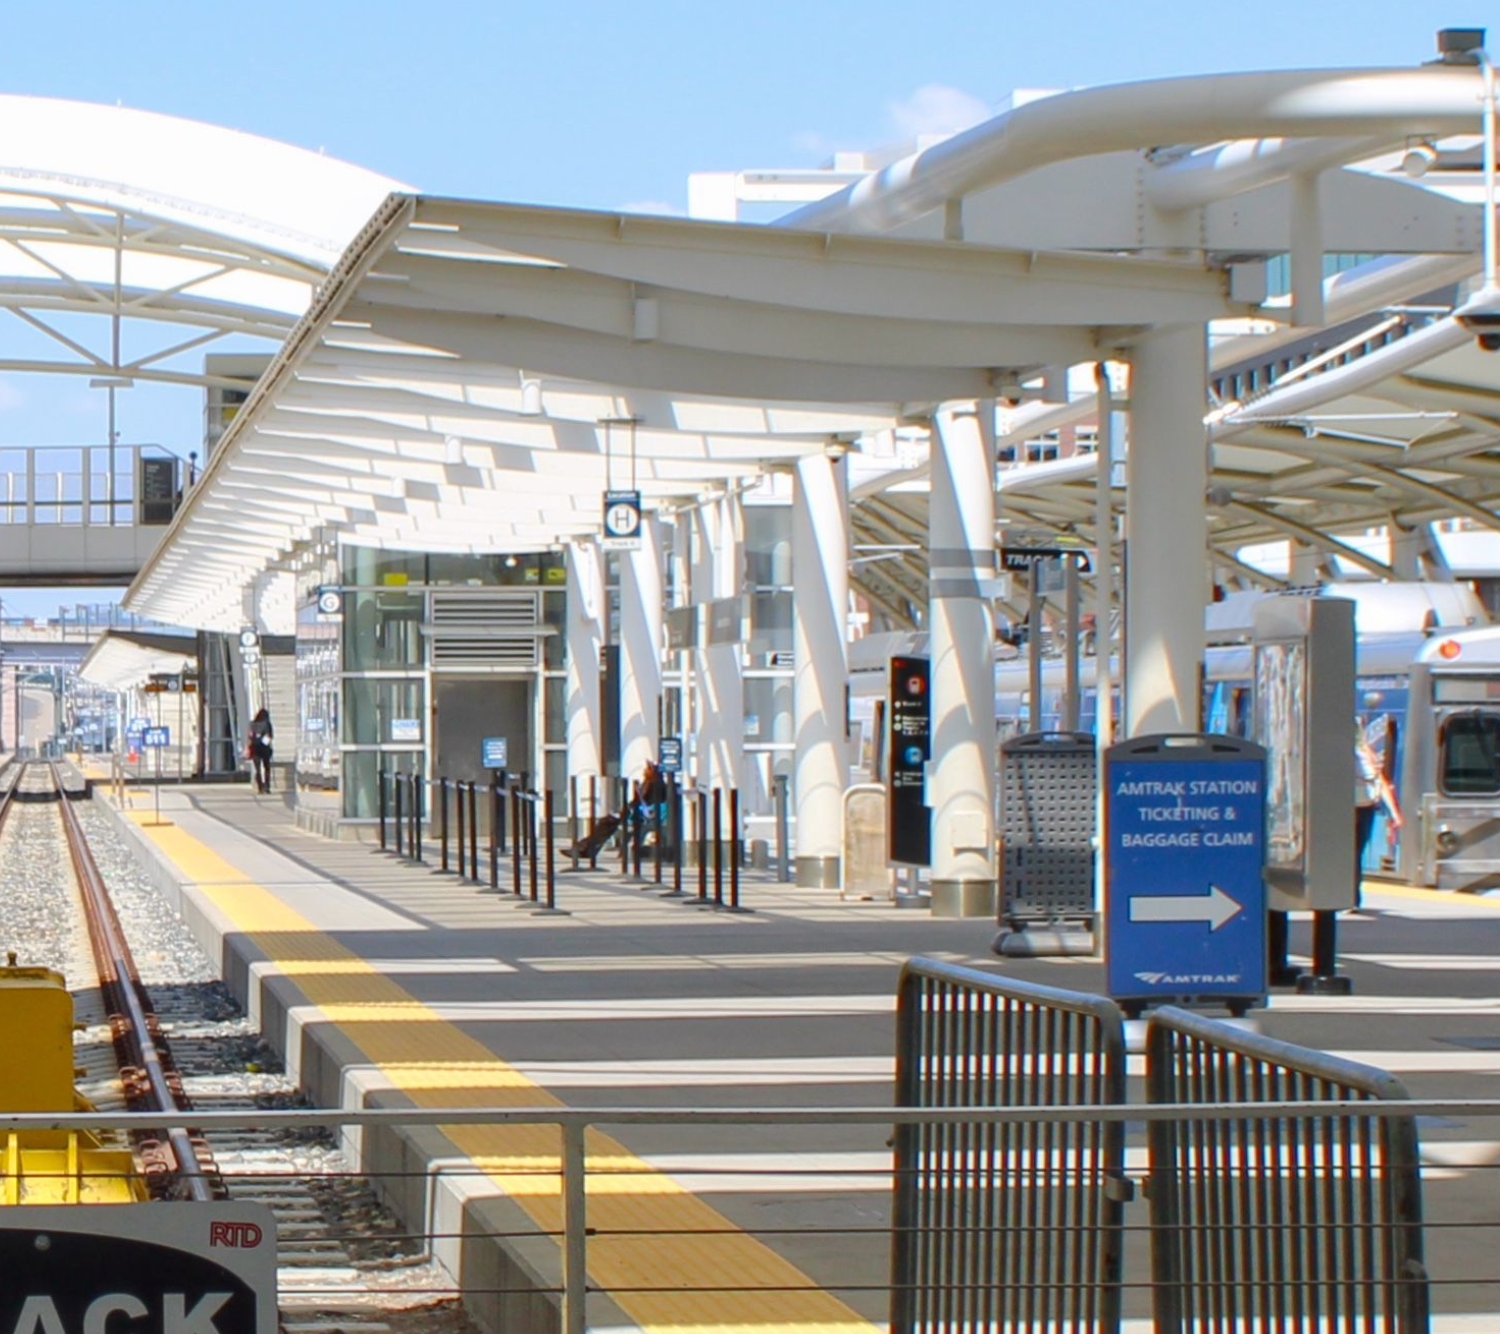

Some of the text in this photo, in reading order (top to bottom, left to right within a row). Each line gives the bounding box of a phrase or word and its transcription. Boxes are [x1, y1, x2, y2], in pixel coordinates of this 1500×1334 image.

[614, 509, 630, 528] H
[1117, 780, 1258, 796] AMTRAK STATION
[1138, 806, 1237, 821] TICKETING &
[1121, 832, 1254, 847] BAGGAGE CLAIM
[1161, 975, 1241, 984] AMTRAK
[210, 1221, 263, 1248] RTD
